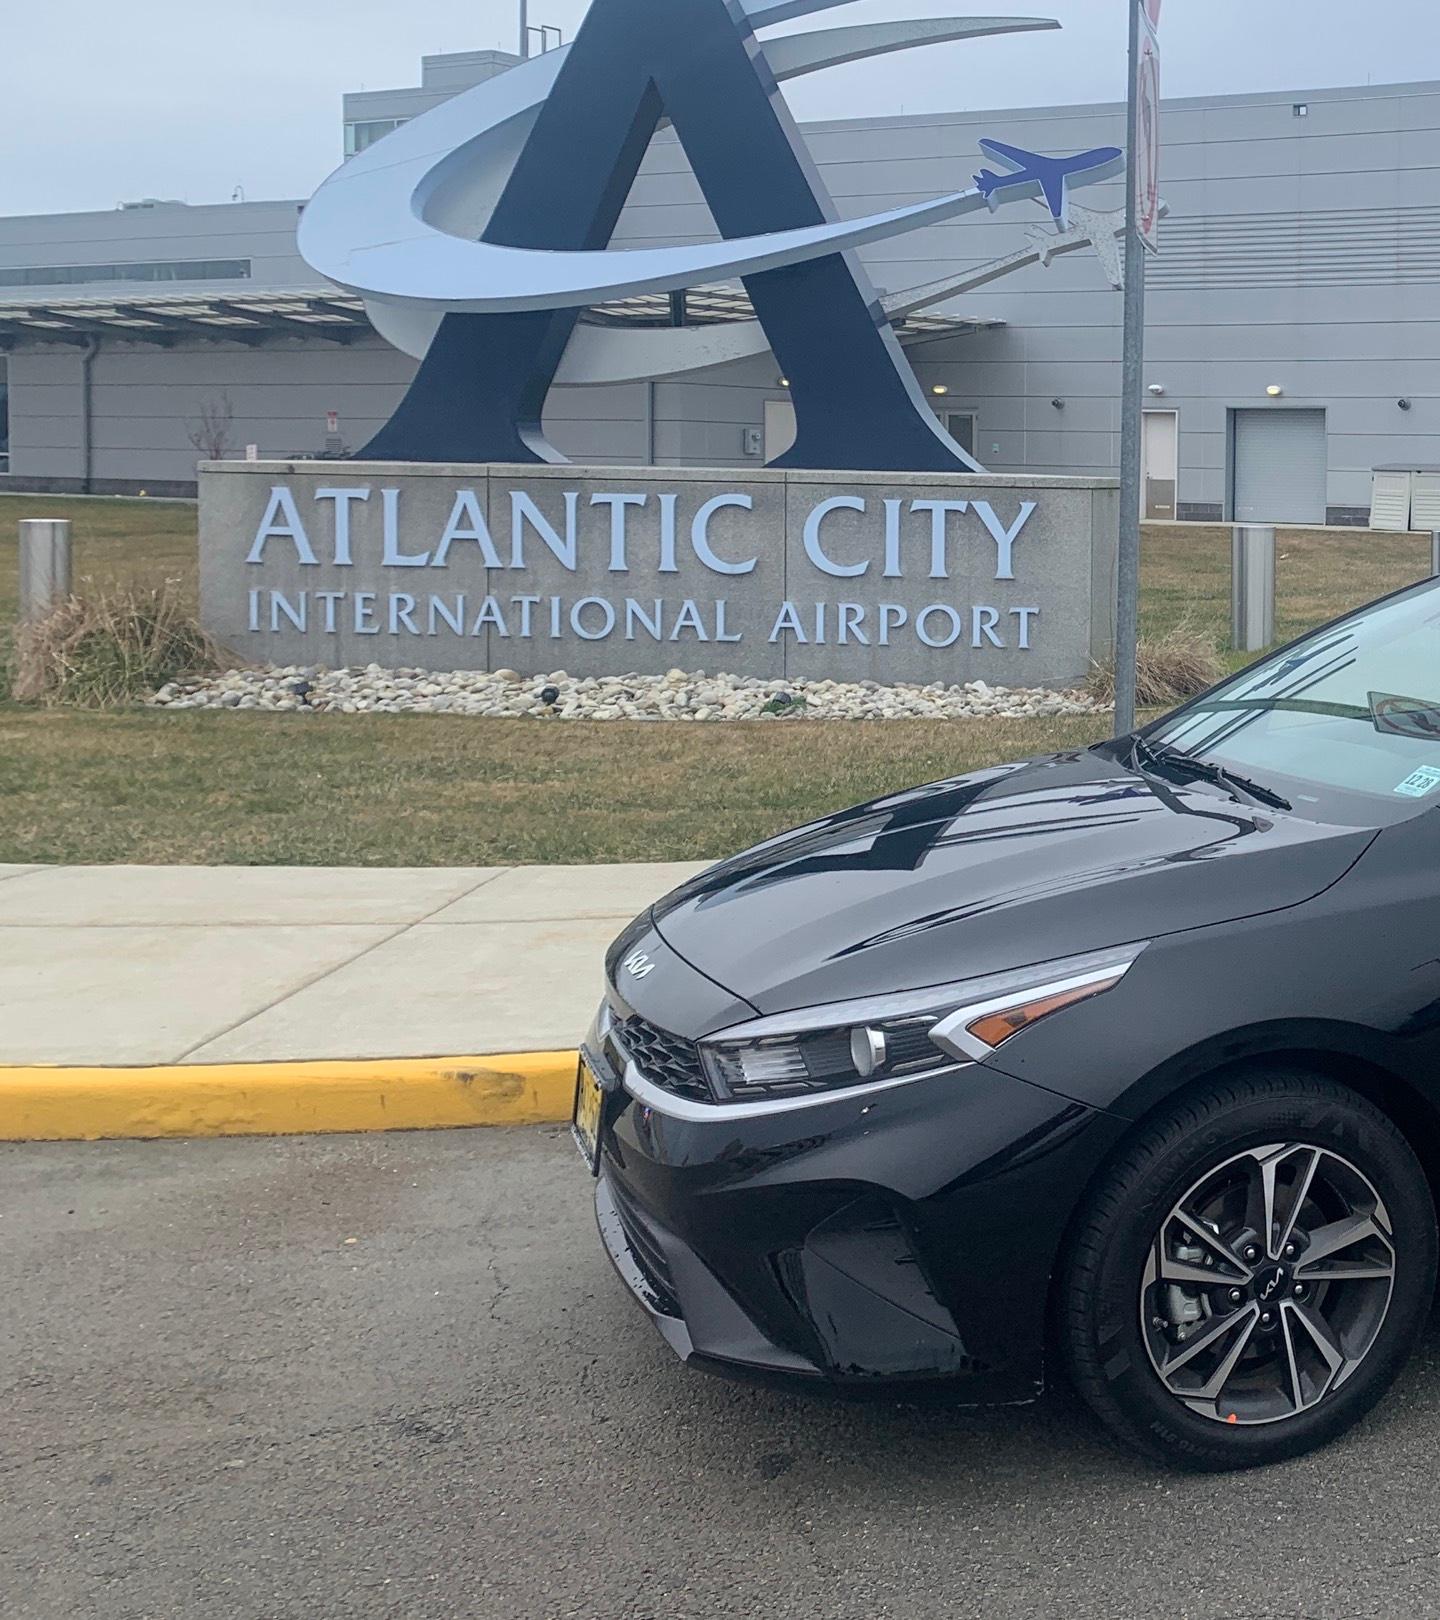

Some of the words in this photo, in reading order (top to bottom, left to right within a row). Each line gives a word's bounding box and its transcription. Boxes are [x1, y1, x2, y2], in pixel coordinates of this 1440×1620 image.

[245, 486, 758, 576] ATLANTIC
[802, 494, 1038, 580] CITY
[248, 588, 743, 642] INTERNATIONAL
[768, 601, 1040, 650] AIRPORT
